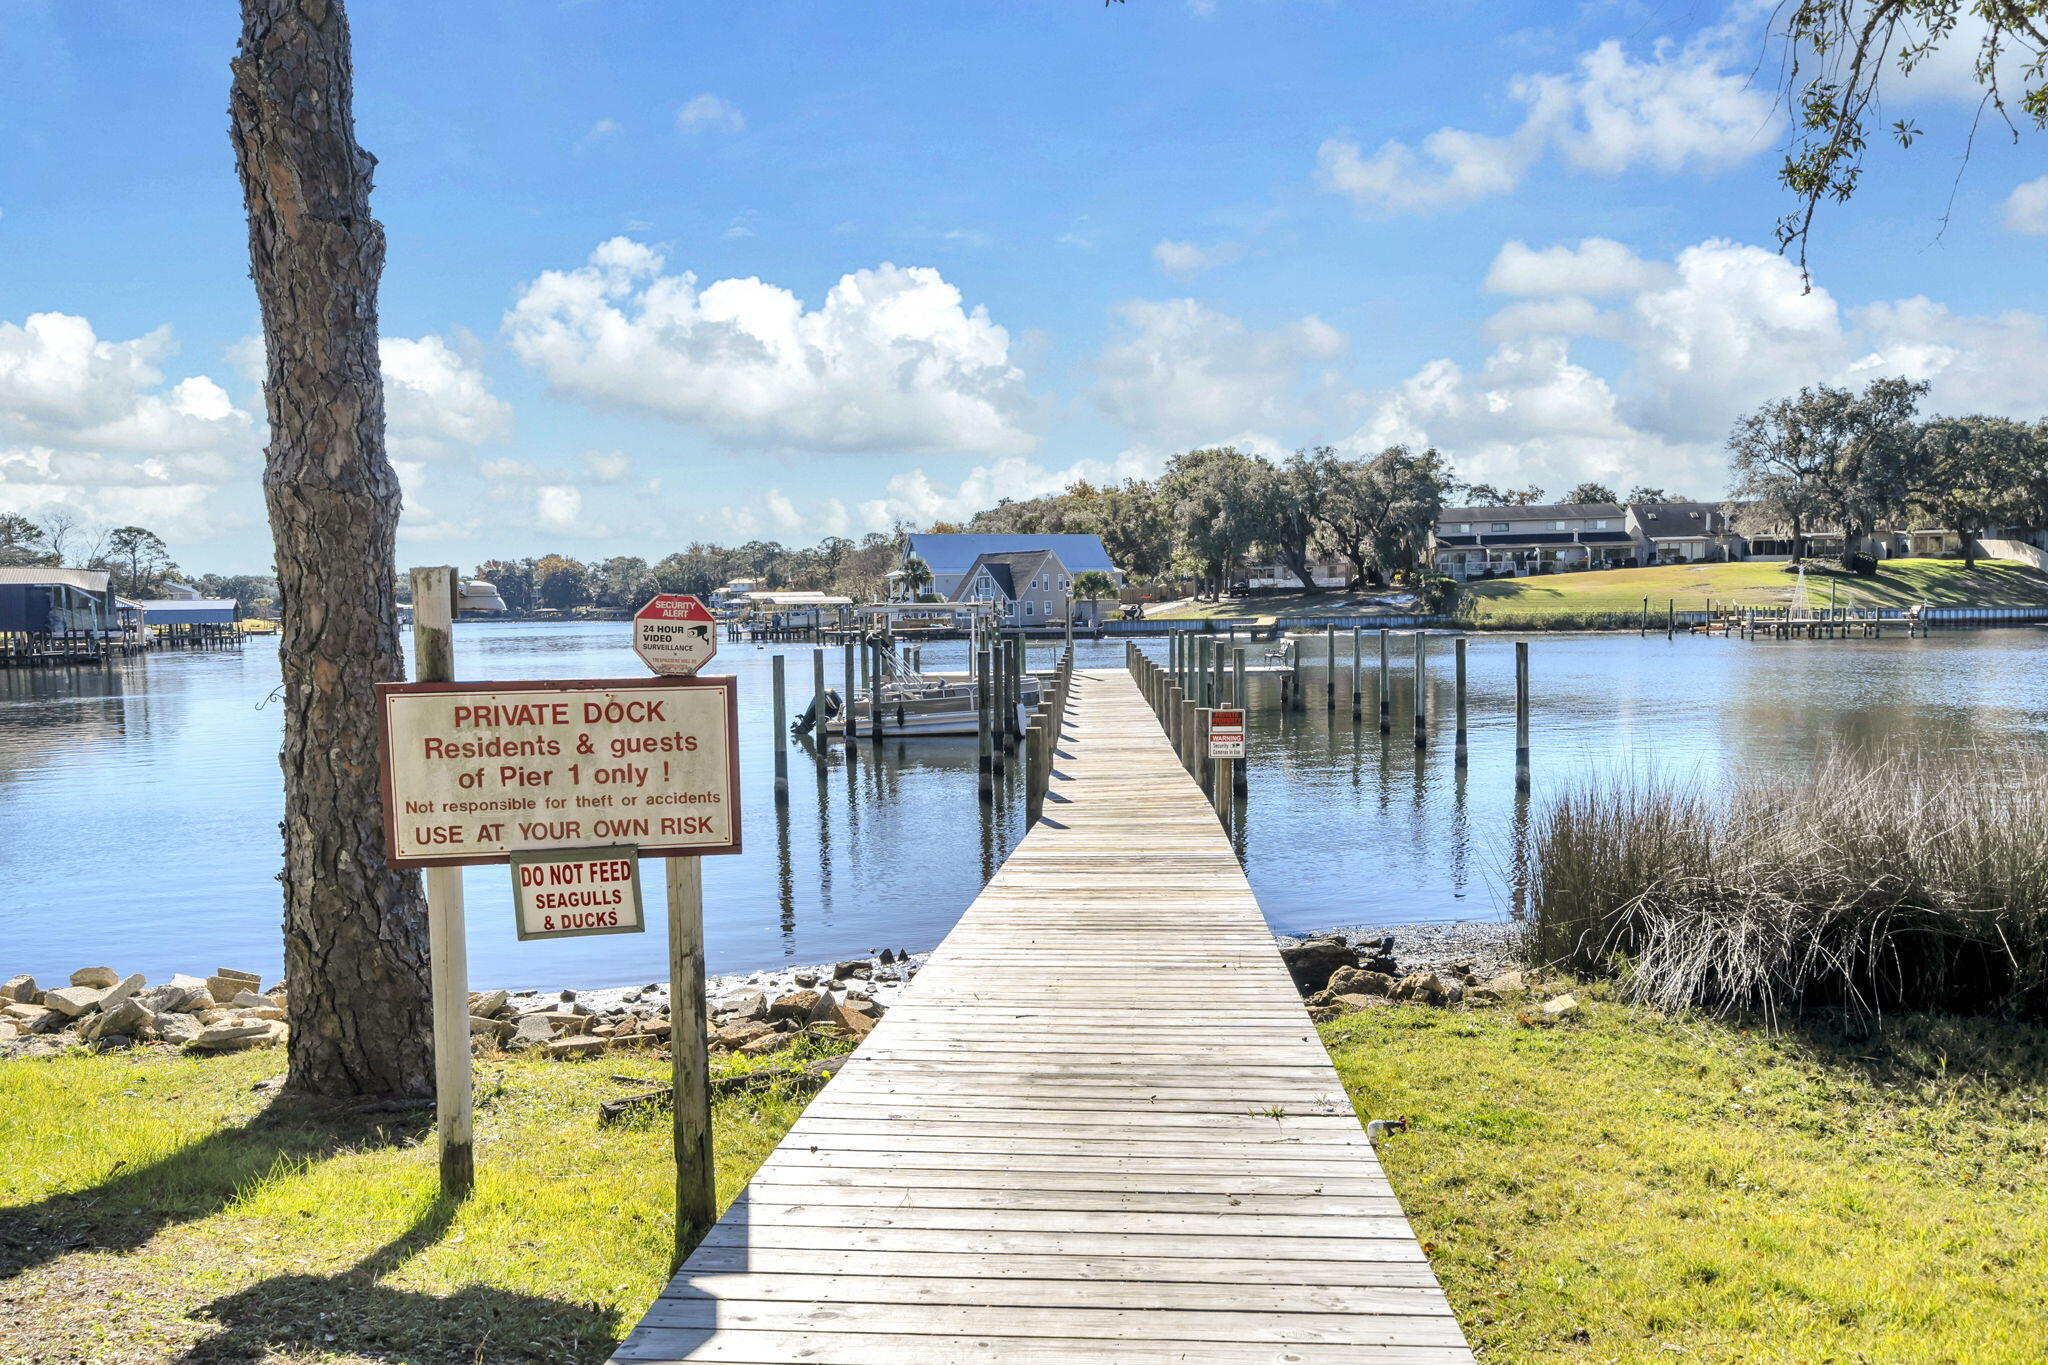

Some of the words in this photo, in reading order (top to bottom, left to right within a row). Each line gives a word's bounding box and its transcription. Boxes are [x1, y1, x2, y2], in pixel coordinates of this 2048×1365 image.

[655, 601, 696, 609] SECURITY
[455, 704, 569, 728] PRIVATE
[584, 701, 666, 724] DOCK
[424, 734, 561, 759] Residents
[576, 734, 594, 755] &
[610, 732, 698, 758] guests
[458, 767, 485, 789] of
[500, 766, 553, 788] Pier
[568, 765, 580, 785] 1
[594, 762, 649, 787] only
[662, 761, 670, 782] !
[406, 800, 434, 814] Not
[442, 797, 536, 814] responsible
[545, 797, 567, 809] for
[576, 795, 613, 808] theft
[621, 795, 638, 806] or
[646, 792, 721, 805] accidents
[415, 825, 464, 845] USE
[477, 824, 505, 842] AT
[519, 821, 581, 841] YOUR
[593, 819, 649, 838] OWN
[661, 816, 714, 835] RISK
[521, 866, 544, 887] DO
[550, 864, 583, 885] NOT
[589, 861, 631, 883] FEED
[536, 890, 622, 909] SEAGULLS
[544, 916, 555, 930] &
[561, 911, 618, 928] DUCKS
